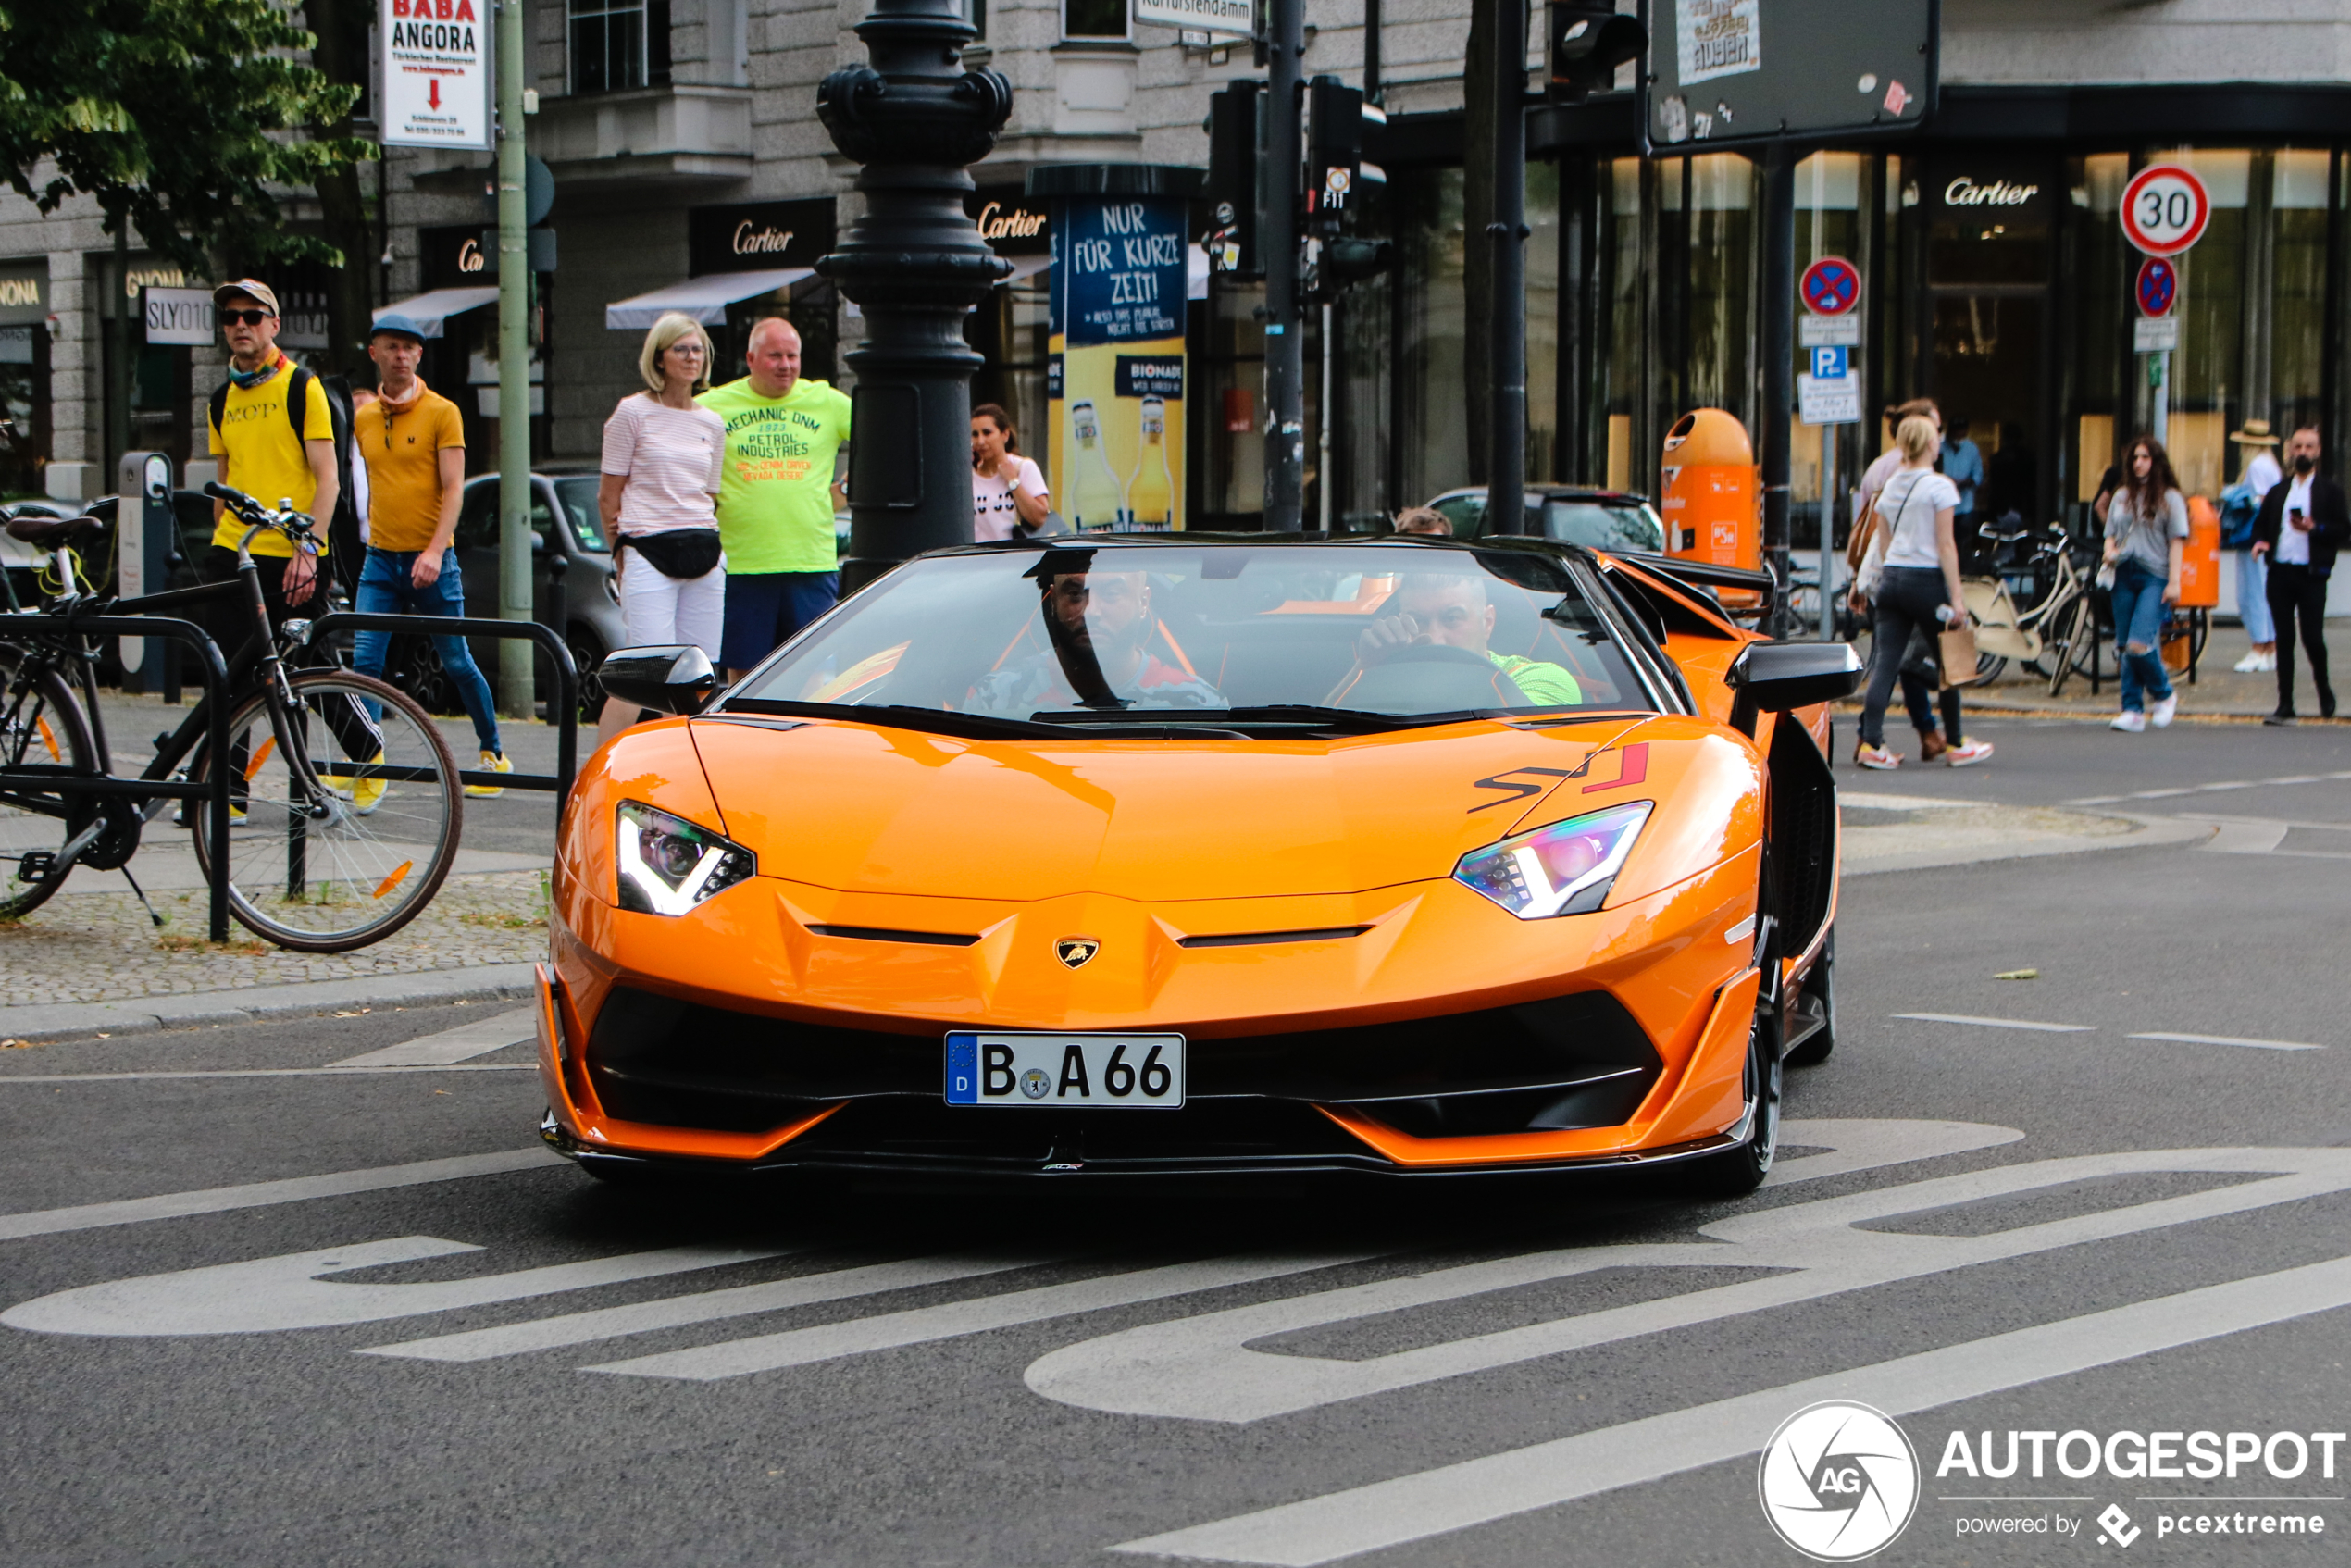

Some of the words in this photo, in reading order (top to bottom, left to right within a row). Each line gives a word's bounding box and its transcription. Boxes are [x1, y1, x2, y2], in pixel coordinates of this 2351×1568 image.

[392, 0, 476, 23] BABA
[392, 21, 476, 53] ANGORA
[1945, 176, 2038, 205] Cartier
[977, 201, 1046, 240] Cartier
[1102, 203, 1146, 235] NUR
[2141, 191, 2188, 228] 30
[733, 218, 793, 255] Cartier
[1075, 238, 1113, 274] FÜR
[1123, 233, 1180, 268] KURZE
[1110, 271, 1158, 305] ZEIT!
[1817, 347, 1836, 377] P
[725, 407, 787, 436] MECHANIC
[738, 443, 809, 458] INDUSTRIES
[748, 434, 797, 446] PETROL
[956, 1076, 968, 1091] D
[981, 1043, 1017, 1096] B
